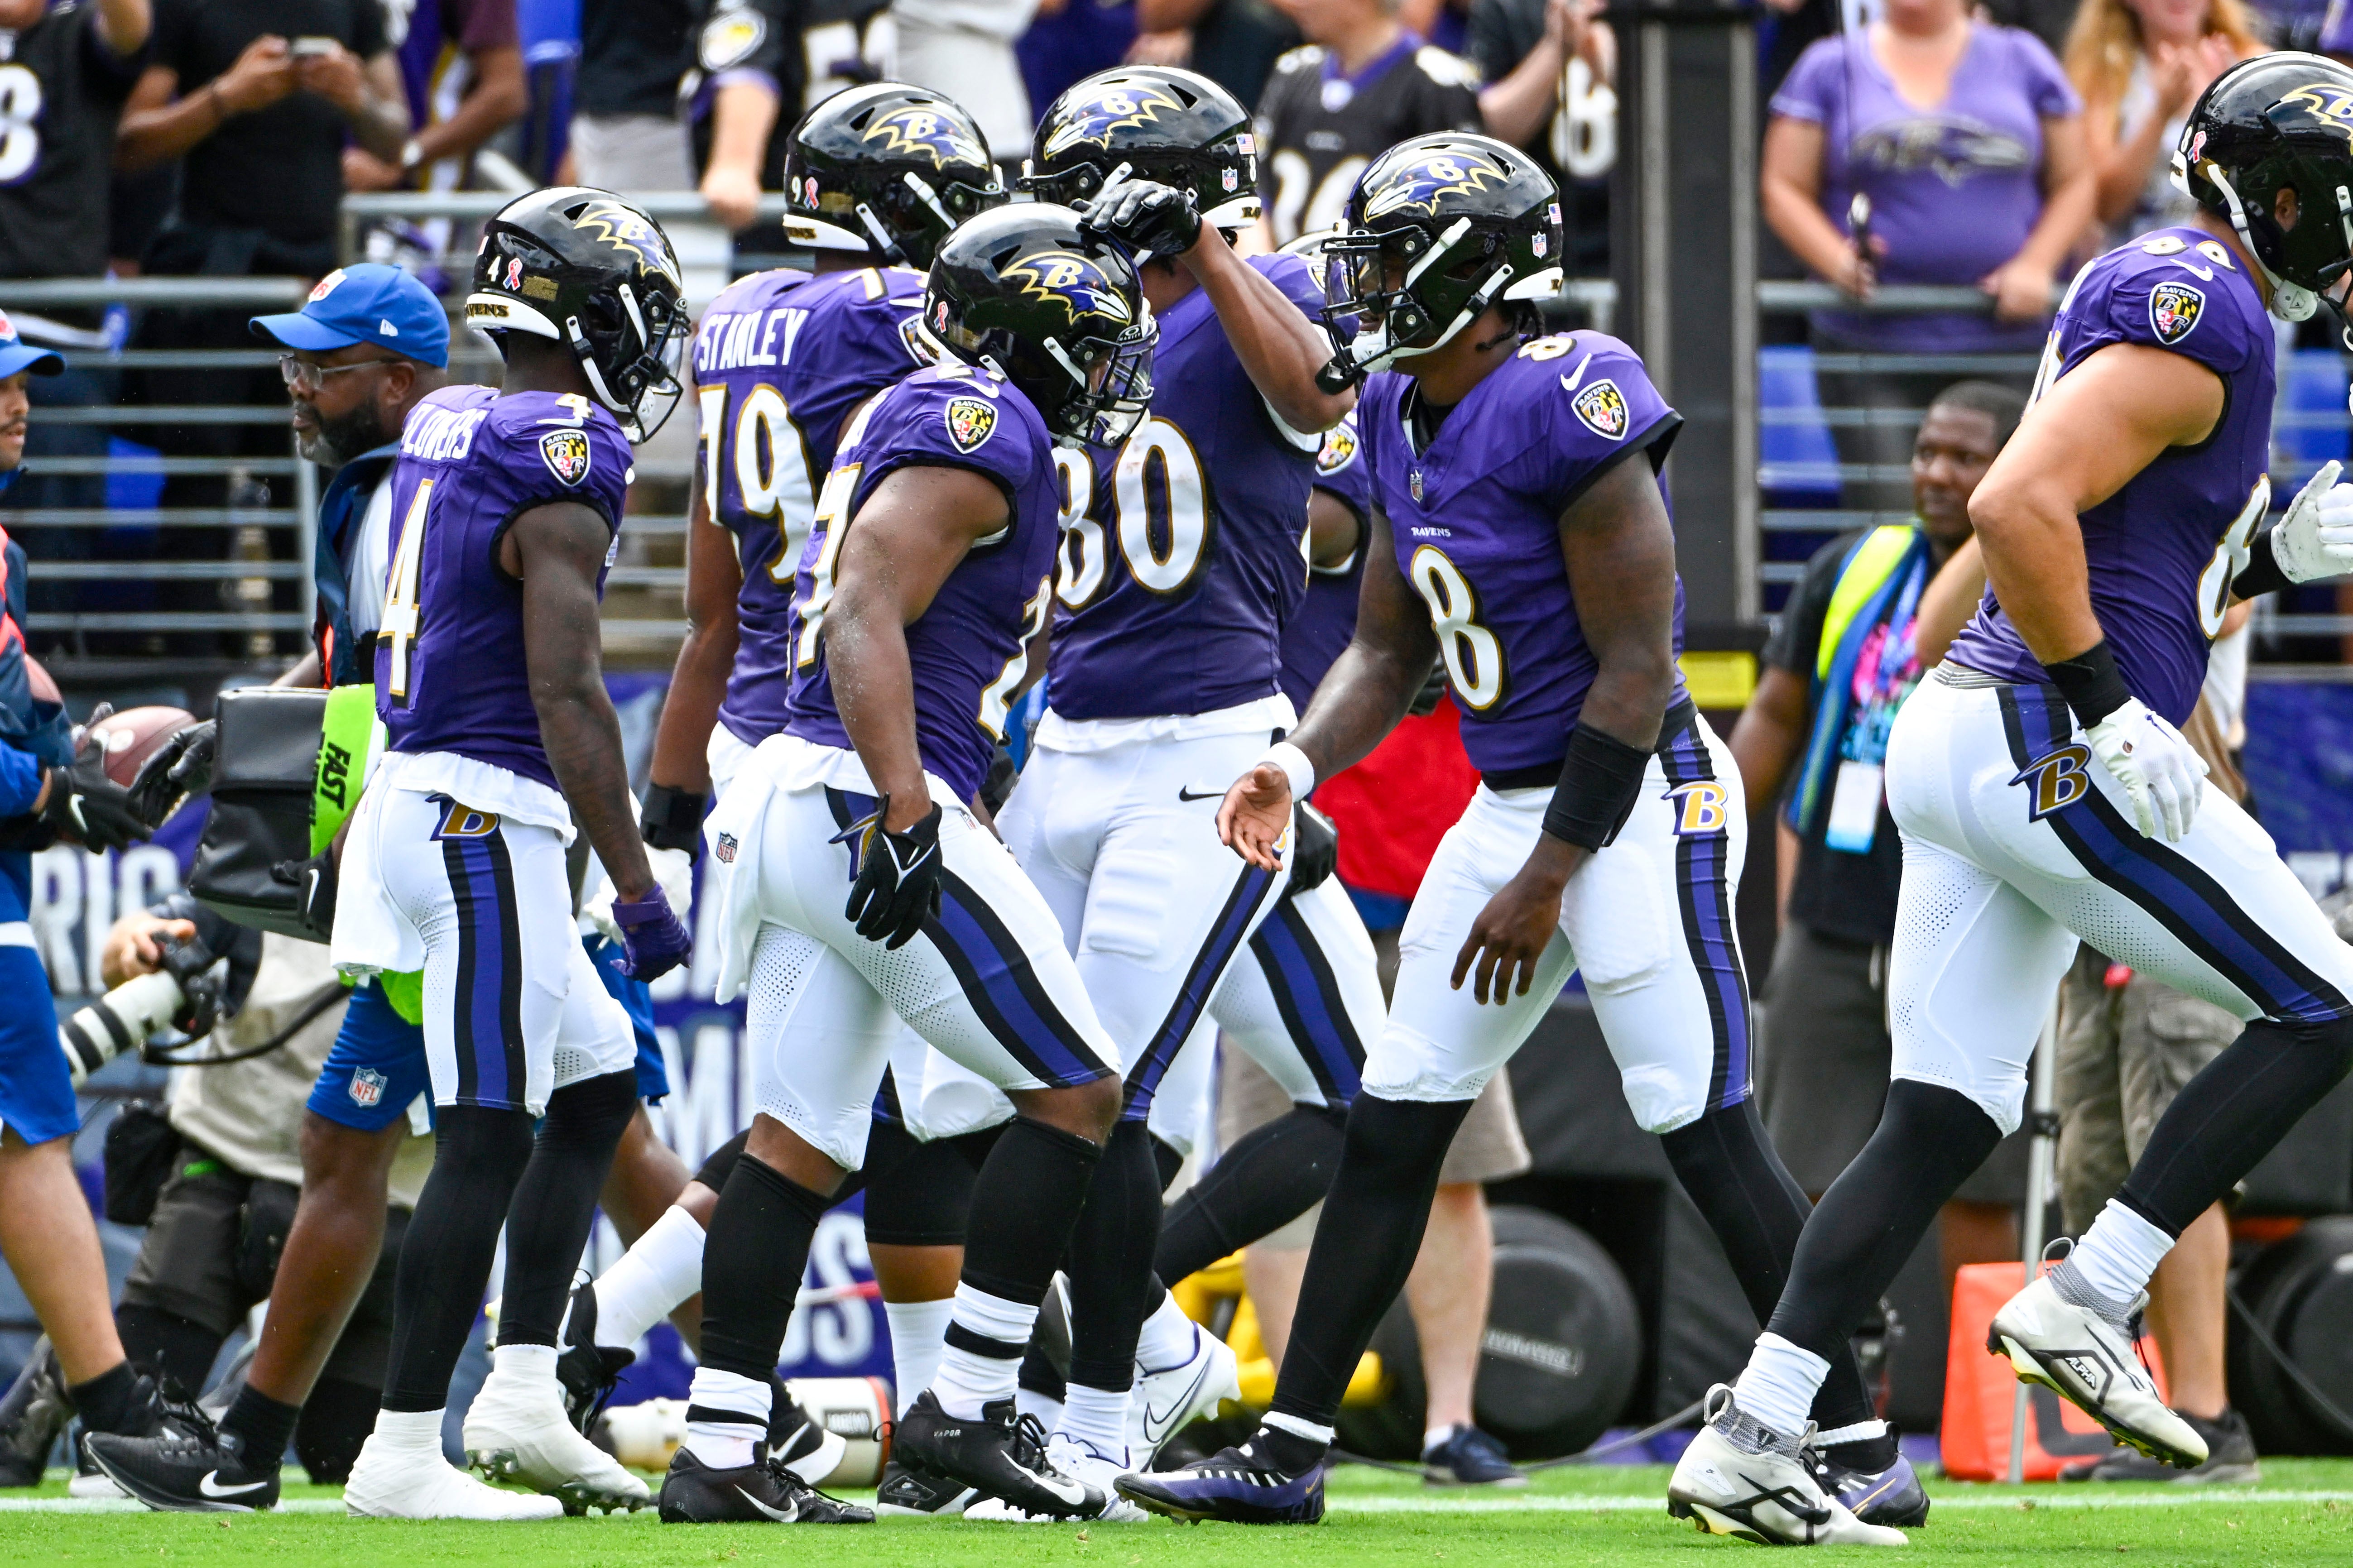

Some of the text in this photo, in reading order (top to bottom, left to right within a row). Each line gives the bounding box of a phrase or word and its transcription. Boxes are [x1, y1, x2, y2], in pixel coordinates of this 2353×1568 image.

[486, 254, 502, 282] 4
[2159, 286, 2199, 302] RAVENS
[699, 307, 809, 372] STANLEY
[953, 401, 993, 416] RAVENS
[1577, 384, 1610, 408] RAVENS
[545, 433, 582, 446] RAVENS
[1411, 527, 1451, 538] RAVENS
[377, 478, 434, 697] 4
[1409, 543, 1503, 710] 8
[320, 741, 351, 811] FAST
[2008, 743, 2091, 826] B
[1661, 780, 1728, 836] B
[717, 842, 735, 861] NFL
[353, 1080, 378, 1103] NFL
[2065, 1357, 2097, 1390] ALPHA
[933, 1428, 962, 1439] VAPOR
